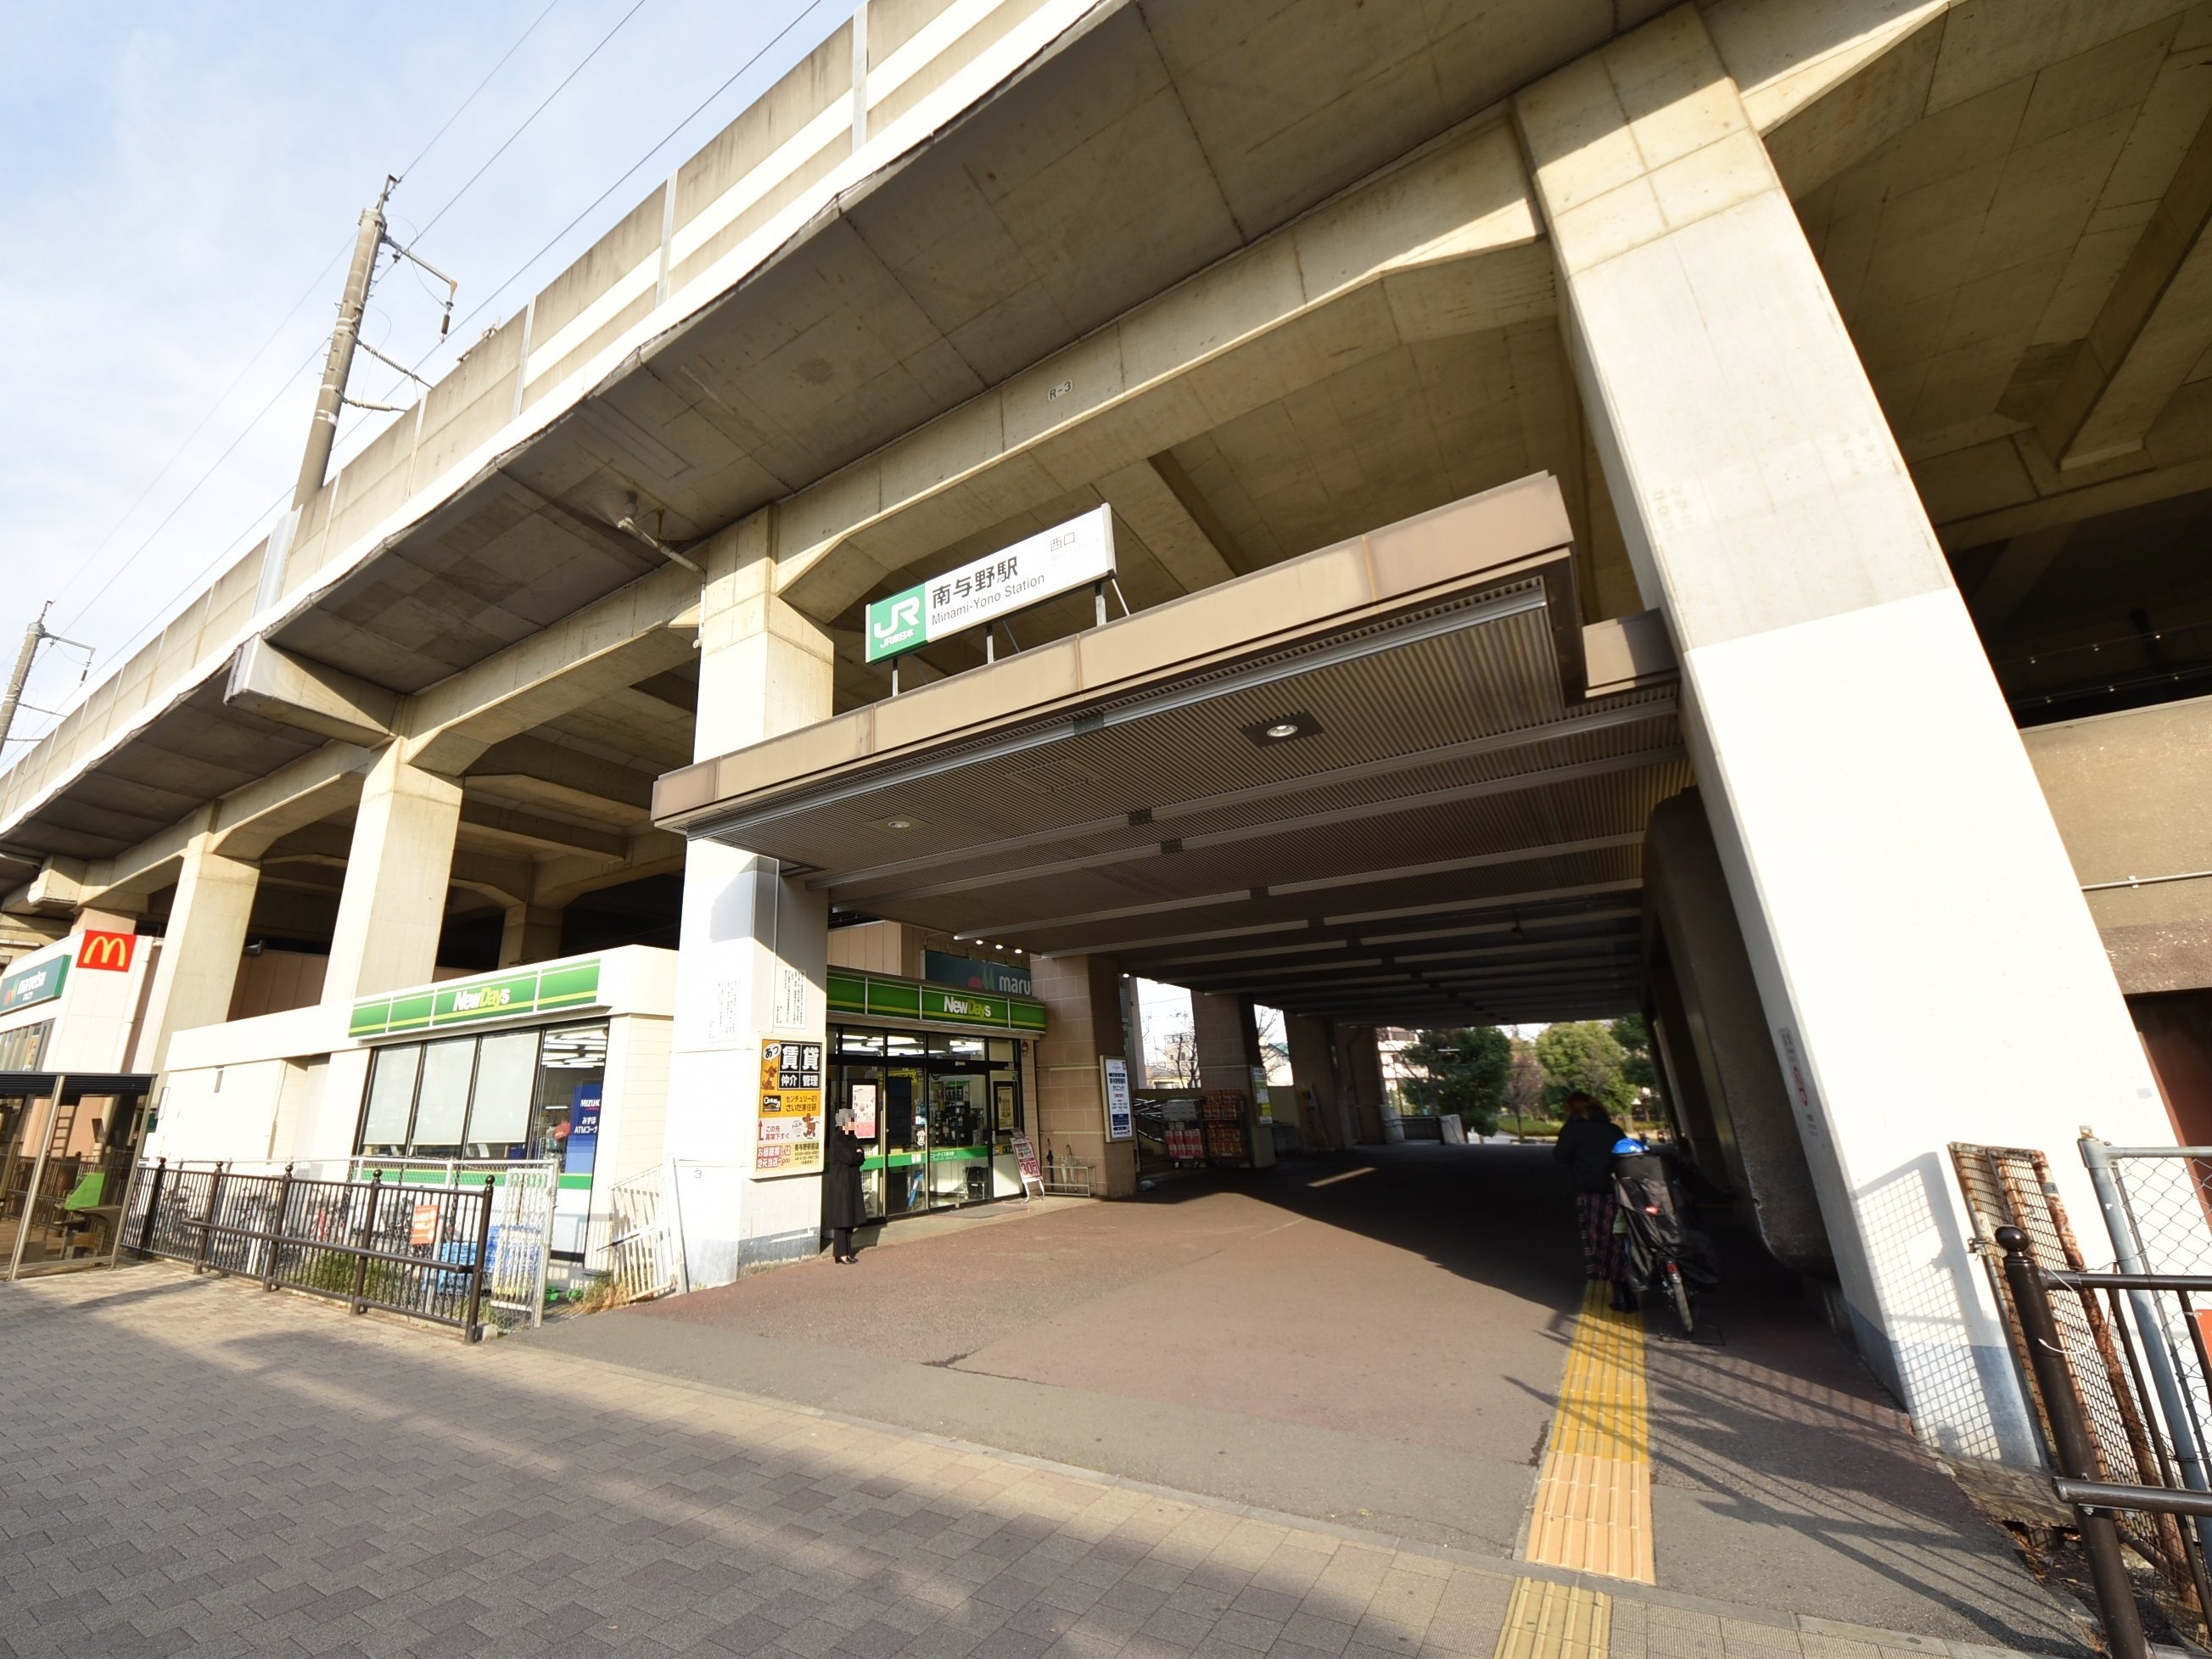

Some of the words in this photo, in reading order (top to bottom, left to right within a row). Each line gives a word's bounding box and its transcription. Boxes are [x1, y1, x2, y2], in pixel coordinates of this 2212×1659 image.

[1050, 381, 1071, 400] R-3
[1050, 532, 1075, 552] 西口
[932, 556, 1017, 609] 南与野駅
[932, 592, 1000, 625] Minami-Yono
[1005, 574, 1044, 597] Station
[874, 596, 920, 638] JR
[453, 987, 511, 1012] NewDays
[944, 995, 991, 1018] NewDays
[781, 1045, 819, 1070] 賃貸
[781, 1074, 798, 1086] 仲介
[803, 1074, 818, 1086] 管理
